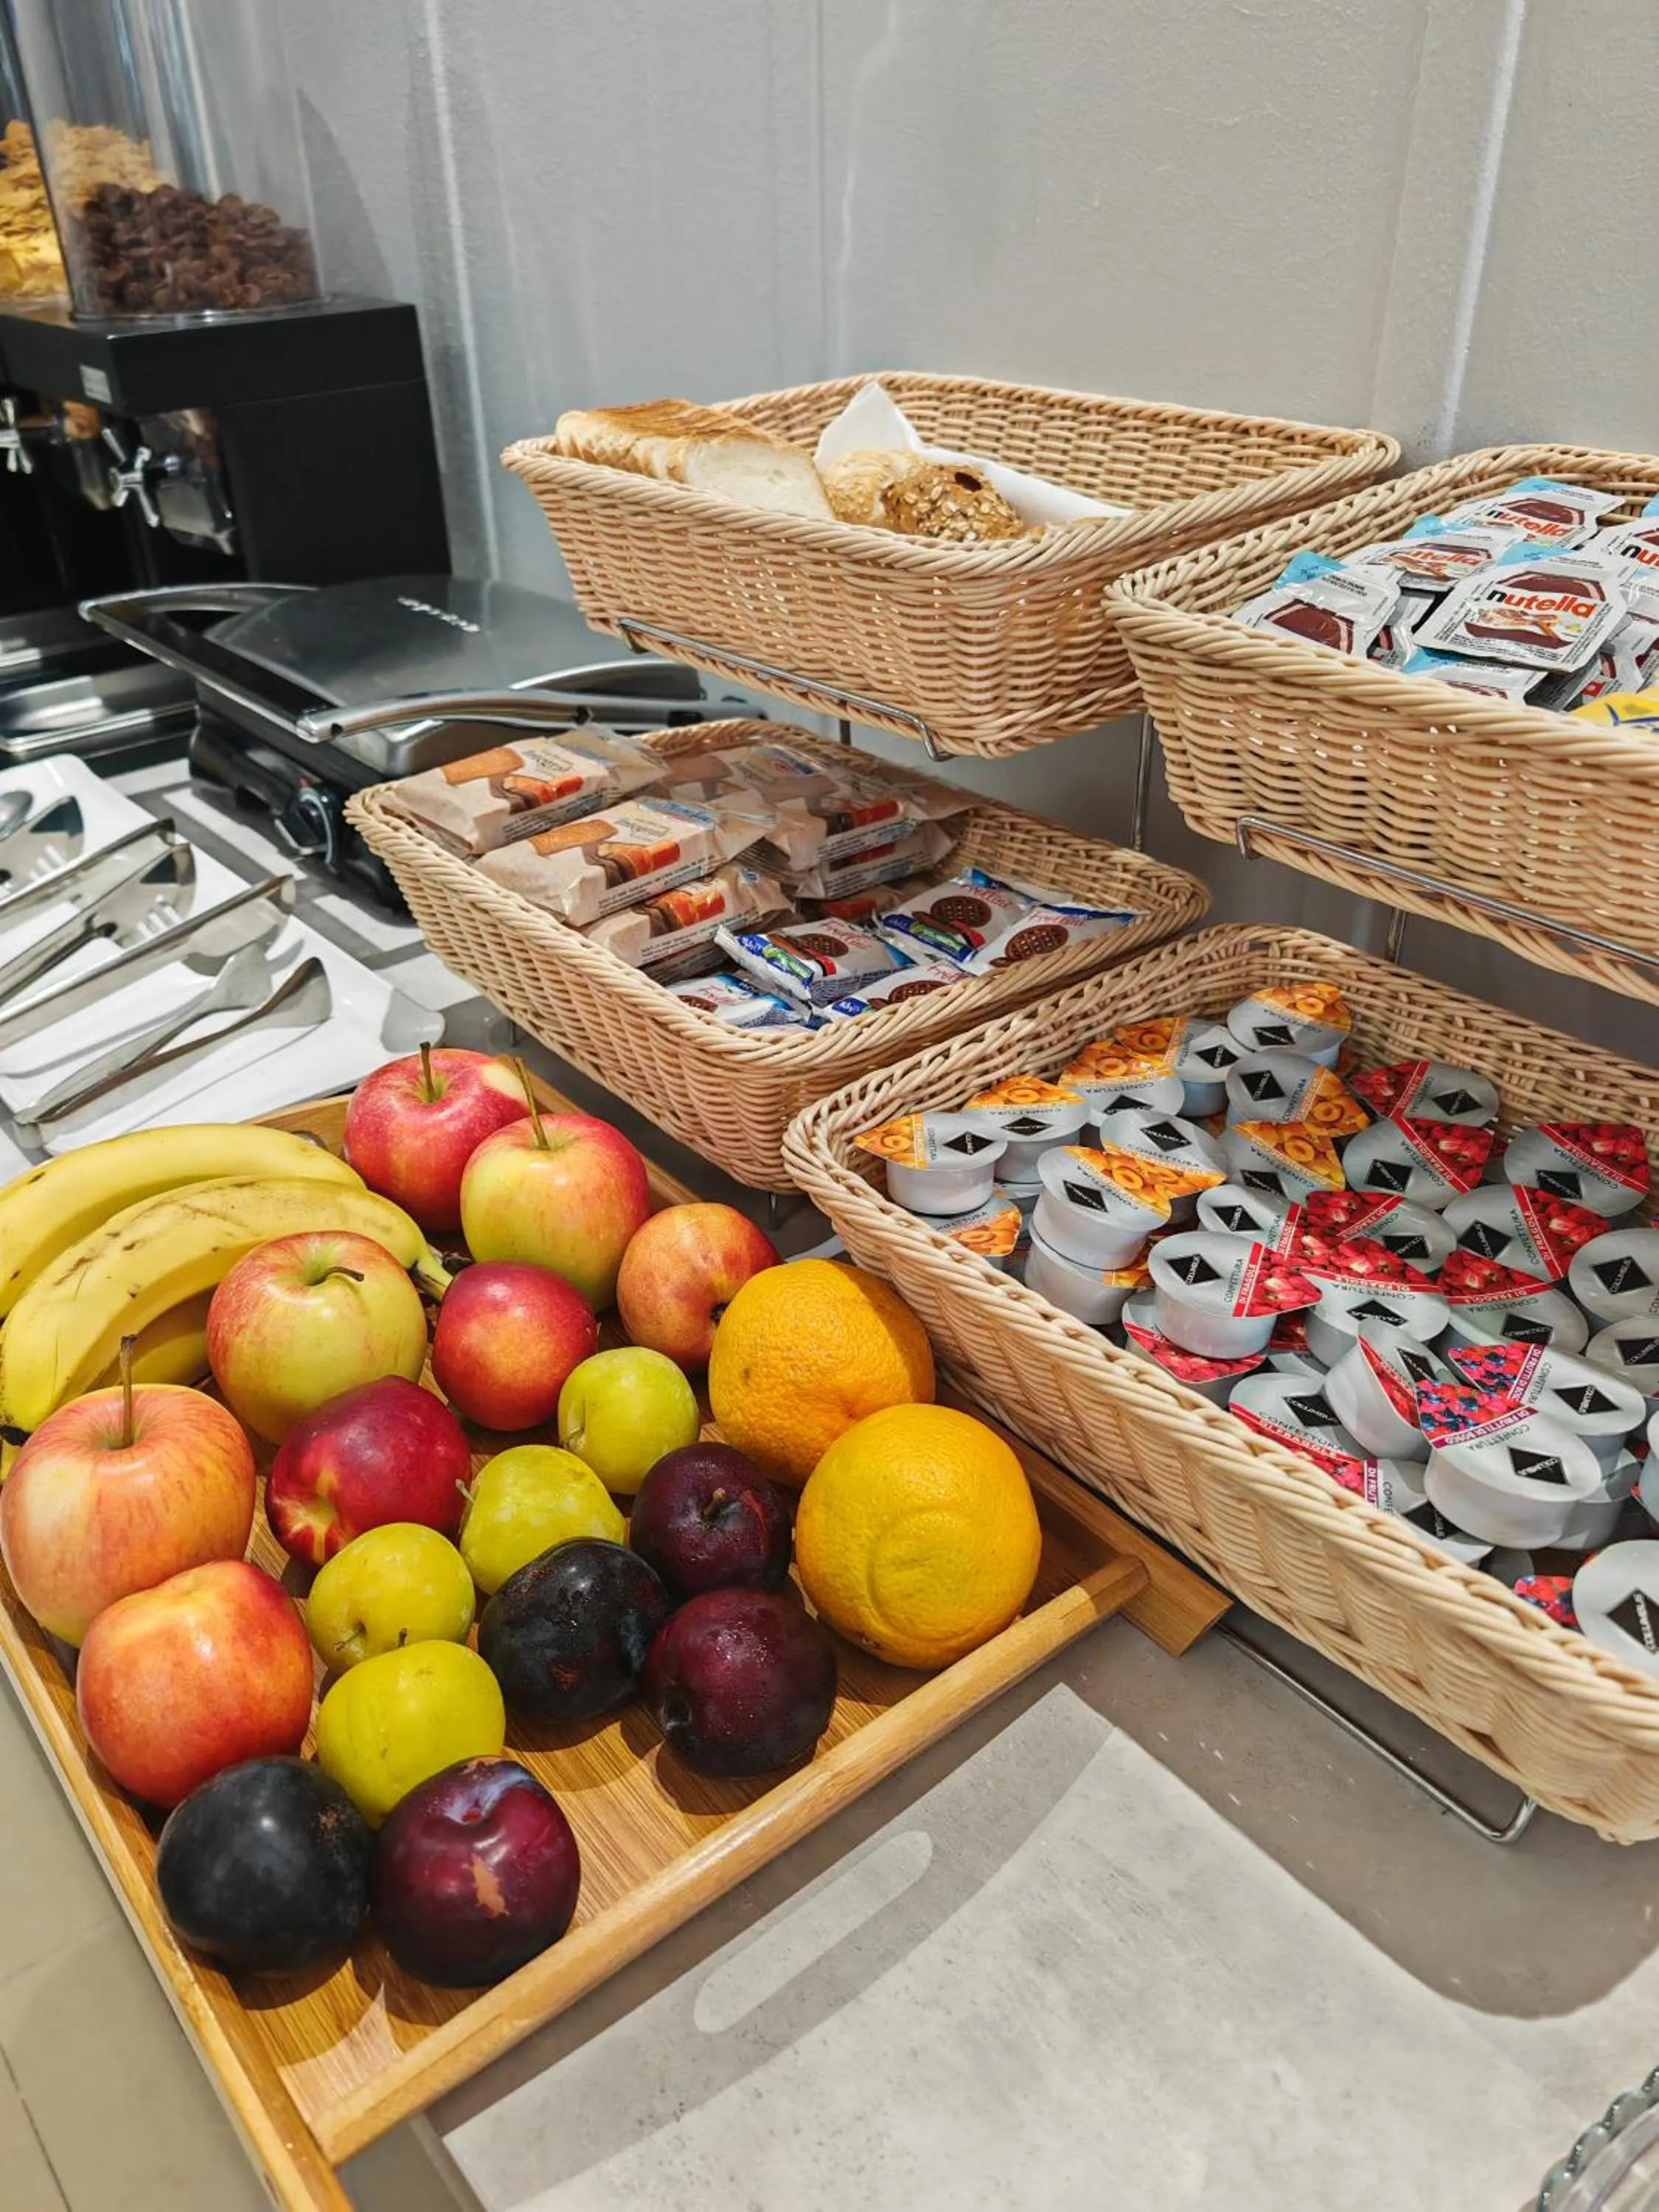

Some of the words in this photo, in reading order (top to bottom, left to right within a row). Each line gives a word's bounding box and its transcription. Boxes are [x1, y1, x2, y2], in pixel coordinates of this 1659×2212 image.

[1488, 509, 1573, 538] nutella
[1621, 543, 1659, 566] nu
[1487, 590, 1596, 618] nutella
[1554, 1147, 1618, 1190] CONFETTURA
[1472, 1221, 1494, 1259] COLUMBUS
[1509, 1208, 1540, 1265] CONFETTURA
[1523, 1209, 1546, 1251] FRAGOLE
[1542, 1249, 1551, 1261] DI
[1222, 1257, 1245, 1303] CONFETTURA
[1332, 1282, 1416, 1301] CONFETTURA
[1467, 1296, 1538, 1315] CONFETTURA
[1530, 1347, 1543, 1358] DI
[1520, 1355, 1538, 1381] FRUTTI
[1526, 1360, 1552, 1405] CONFETTURA
[1517, 1408, 1529, 1419] DI
[1577, 1385, 1596, 1414] COLUMBUS
[1258, 1410, 1343, 1453] CONFETTURA
[1475, 1426, 1486, 1436] DI
[1485, 1413, 1519, 1432] FRUTTI
[1259, 1419, 1272, 1429] DI
[1275, 1427, 1336, 1458] FRAGOLE
[1444, 1428, 1474, 1446] BOSCO
[1465, 1422, 1531, 1454] CONFETTURA
[1368, 1467, 1376, 1477] DI
